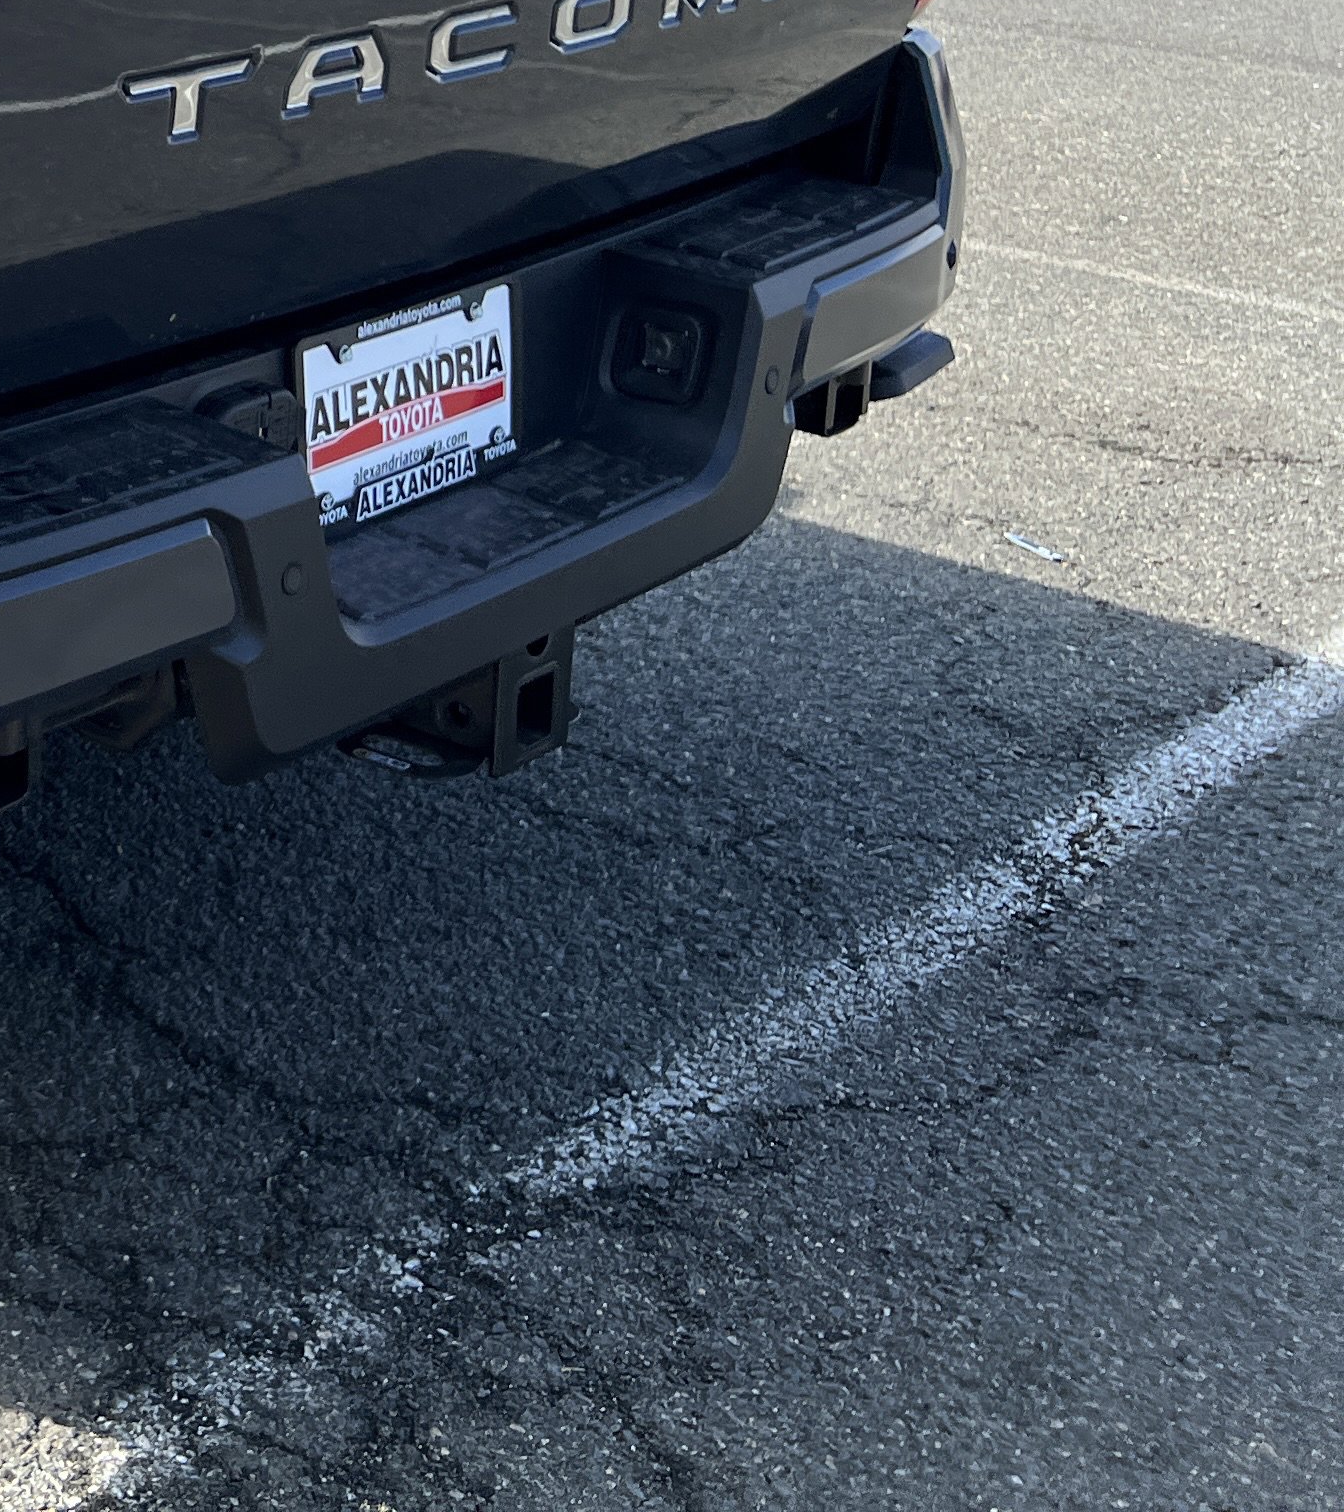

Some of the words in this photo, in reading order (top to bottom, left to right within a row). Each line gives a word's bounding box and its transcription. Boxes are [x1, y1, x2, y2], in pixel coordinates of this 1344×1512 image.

[357, 294, 462, 339] alexandriatoyota.com
[311, 333, 505, 443] ALEXANDRIA
[378, 396, 445, 443] TOYOTA
[483, 439, 517, 461] TOYOTA
[357, 448, 476, 521] ALEXANDRIA
